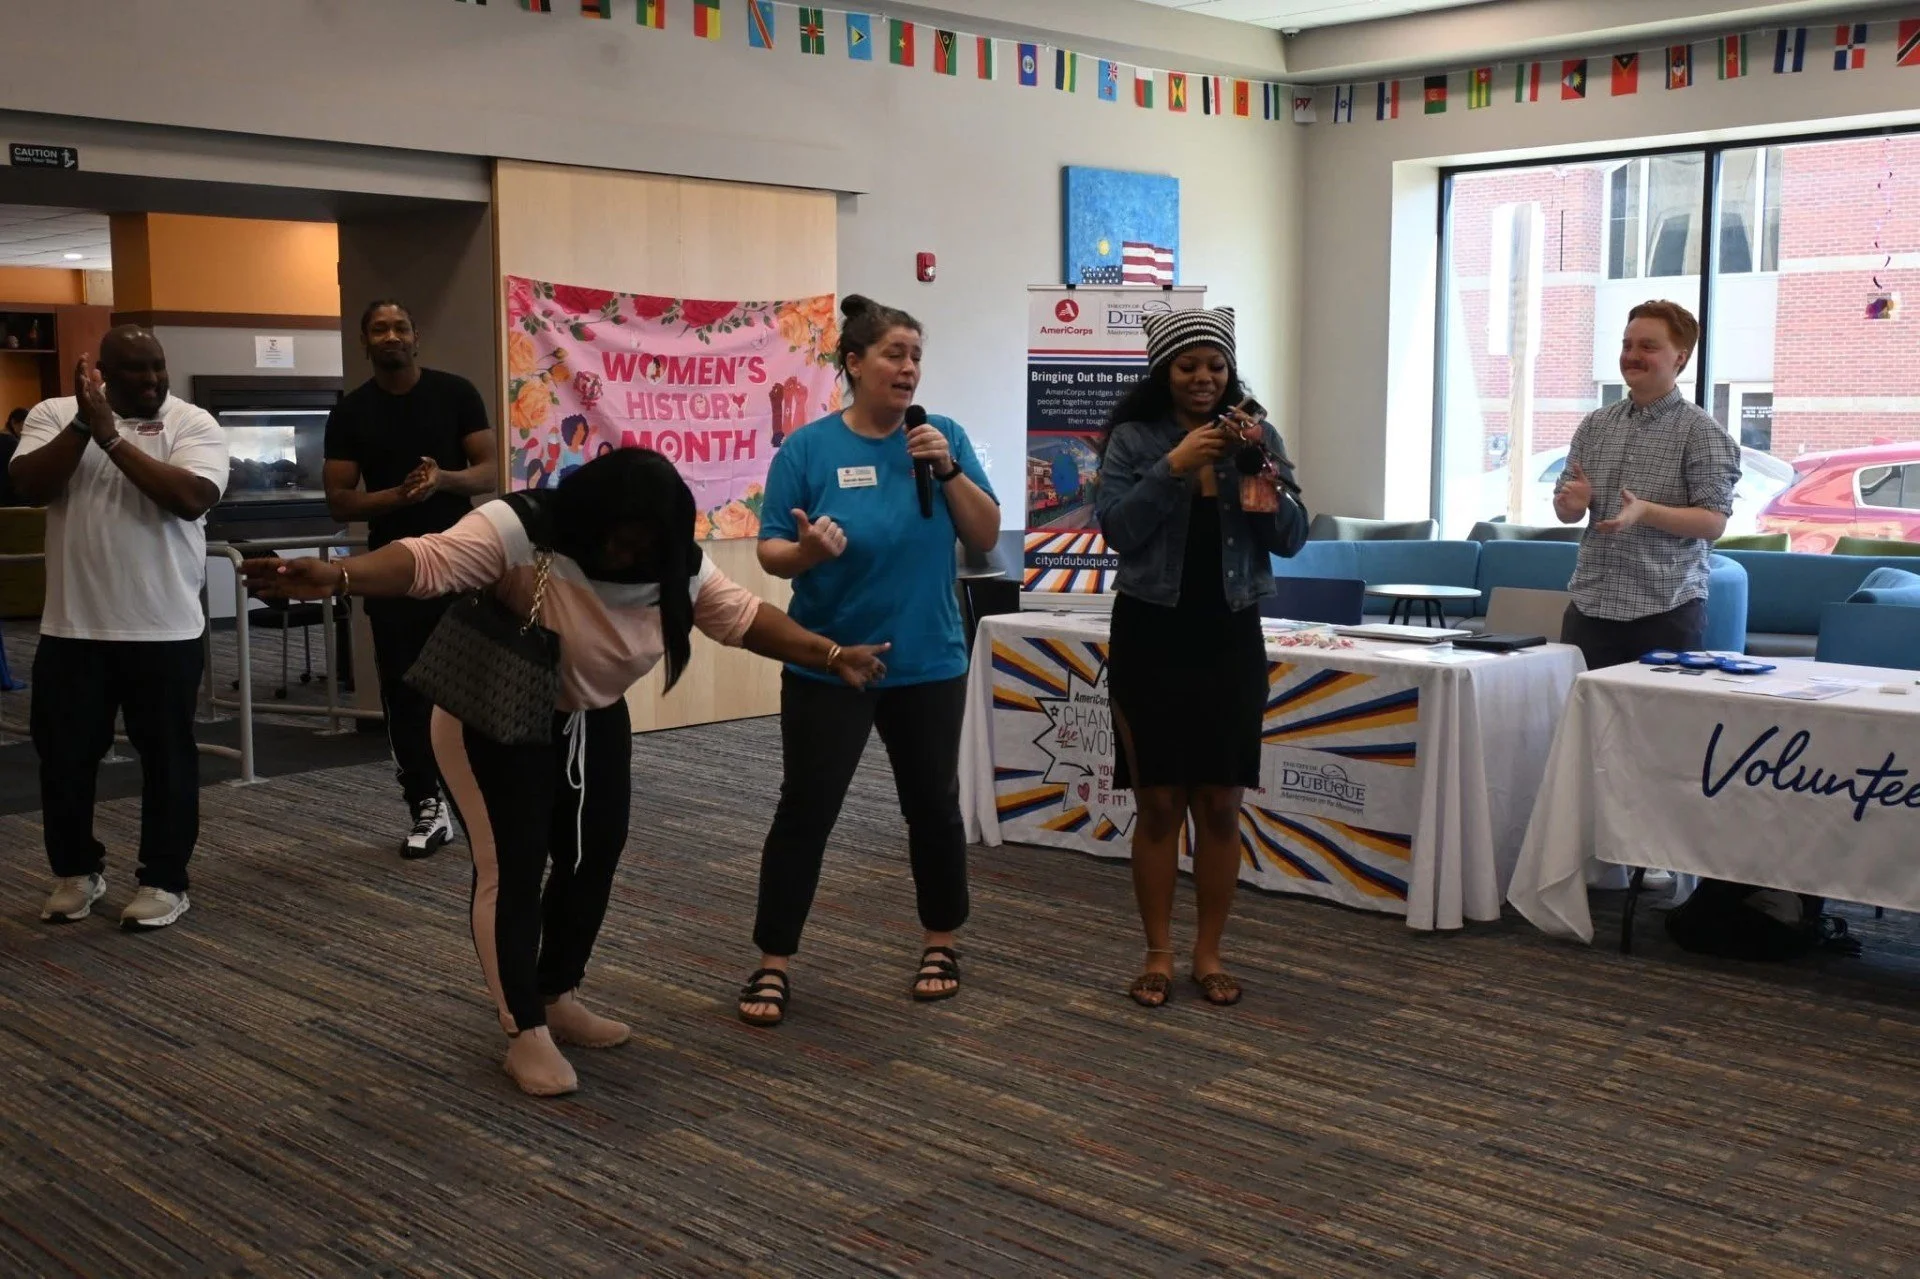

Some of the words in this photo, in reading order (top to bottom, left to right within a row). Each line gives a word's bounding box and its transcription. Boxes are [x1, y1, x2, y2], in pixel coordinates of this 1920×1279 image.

[14, 147, 58, 158] CAUTION
[1040, 326, 1093, 337] AmeriCorps
[602, 351, 768, 386] WOMEN'S
[1031, 371, 1074, 384] Bringing
[1077, 372, 1094, 383] Out
[1096, 372, 1113, 383] the
[1116, 372, 1139, 383] Best
[1045, 388, 1086, 397] AmeriCorps
[1087, 388, 1114, 397] bridges
[626, 391, 748, 421] HISTORY
[1041, 408, 1088, 416] organizations
[1068, 417, 1084, 425] their
[621, 430, 758, 464] MONTH
[1035, 555, 1118, 568] cityofdubuque.o
[1063, 705, 1111, 730] CHAN
[1056, 726, 1079, 741] the
[1702, 723, 1920, 822] Voluntee
[1097, 778, 1109, 791] BE
[1282, 769, 1365, 801] DUBUQUE
[1097, 793, 1110, 805] OF
[1112, 795, 1127, 806] IT!
[1281, 791, 1317, 803] Masterpiece
